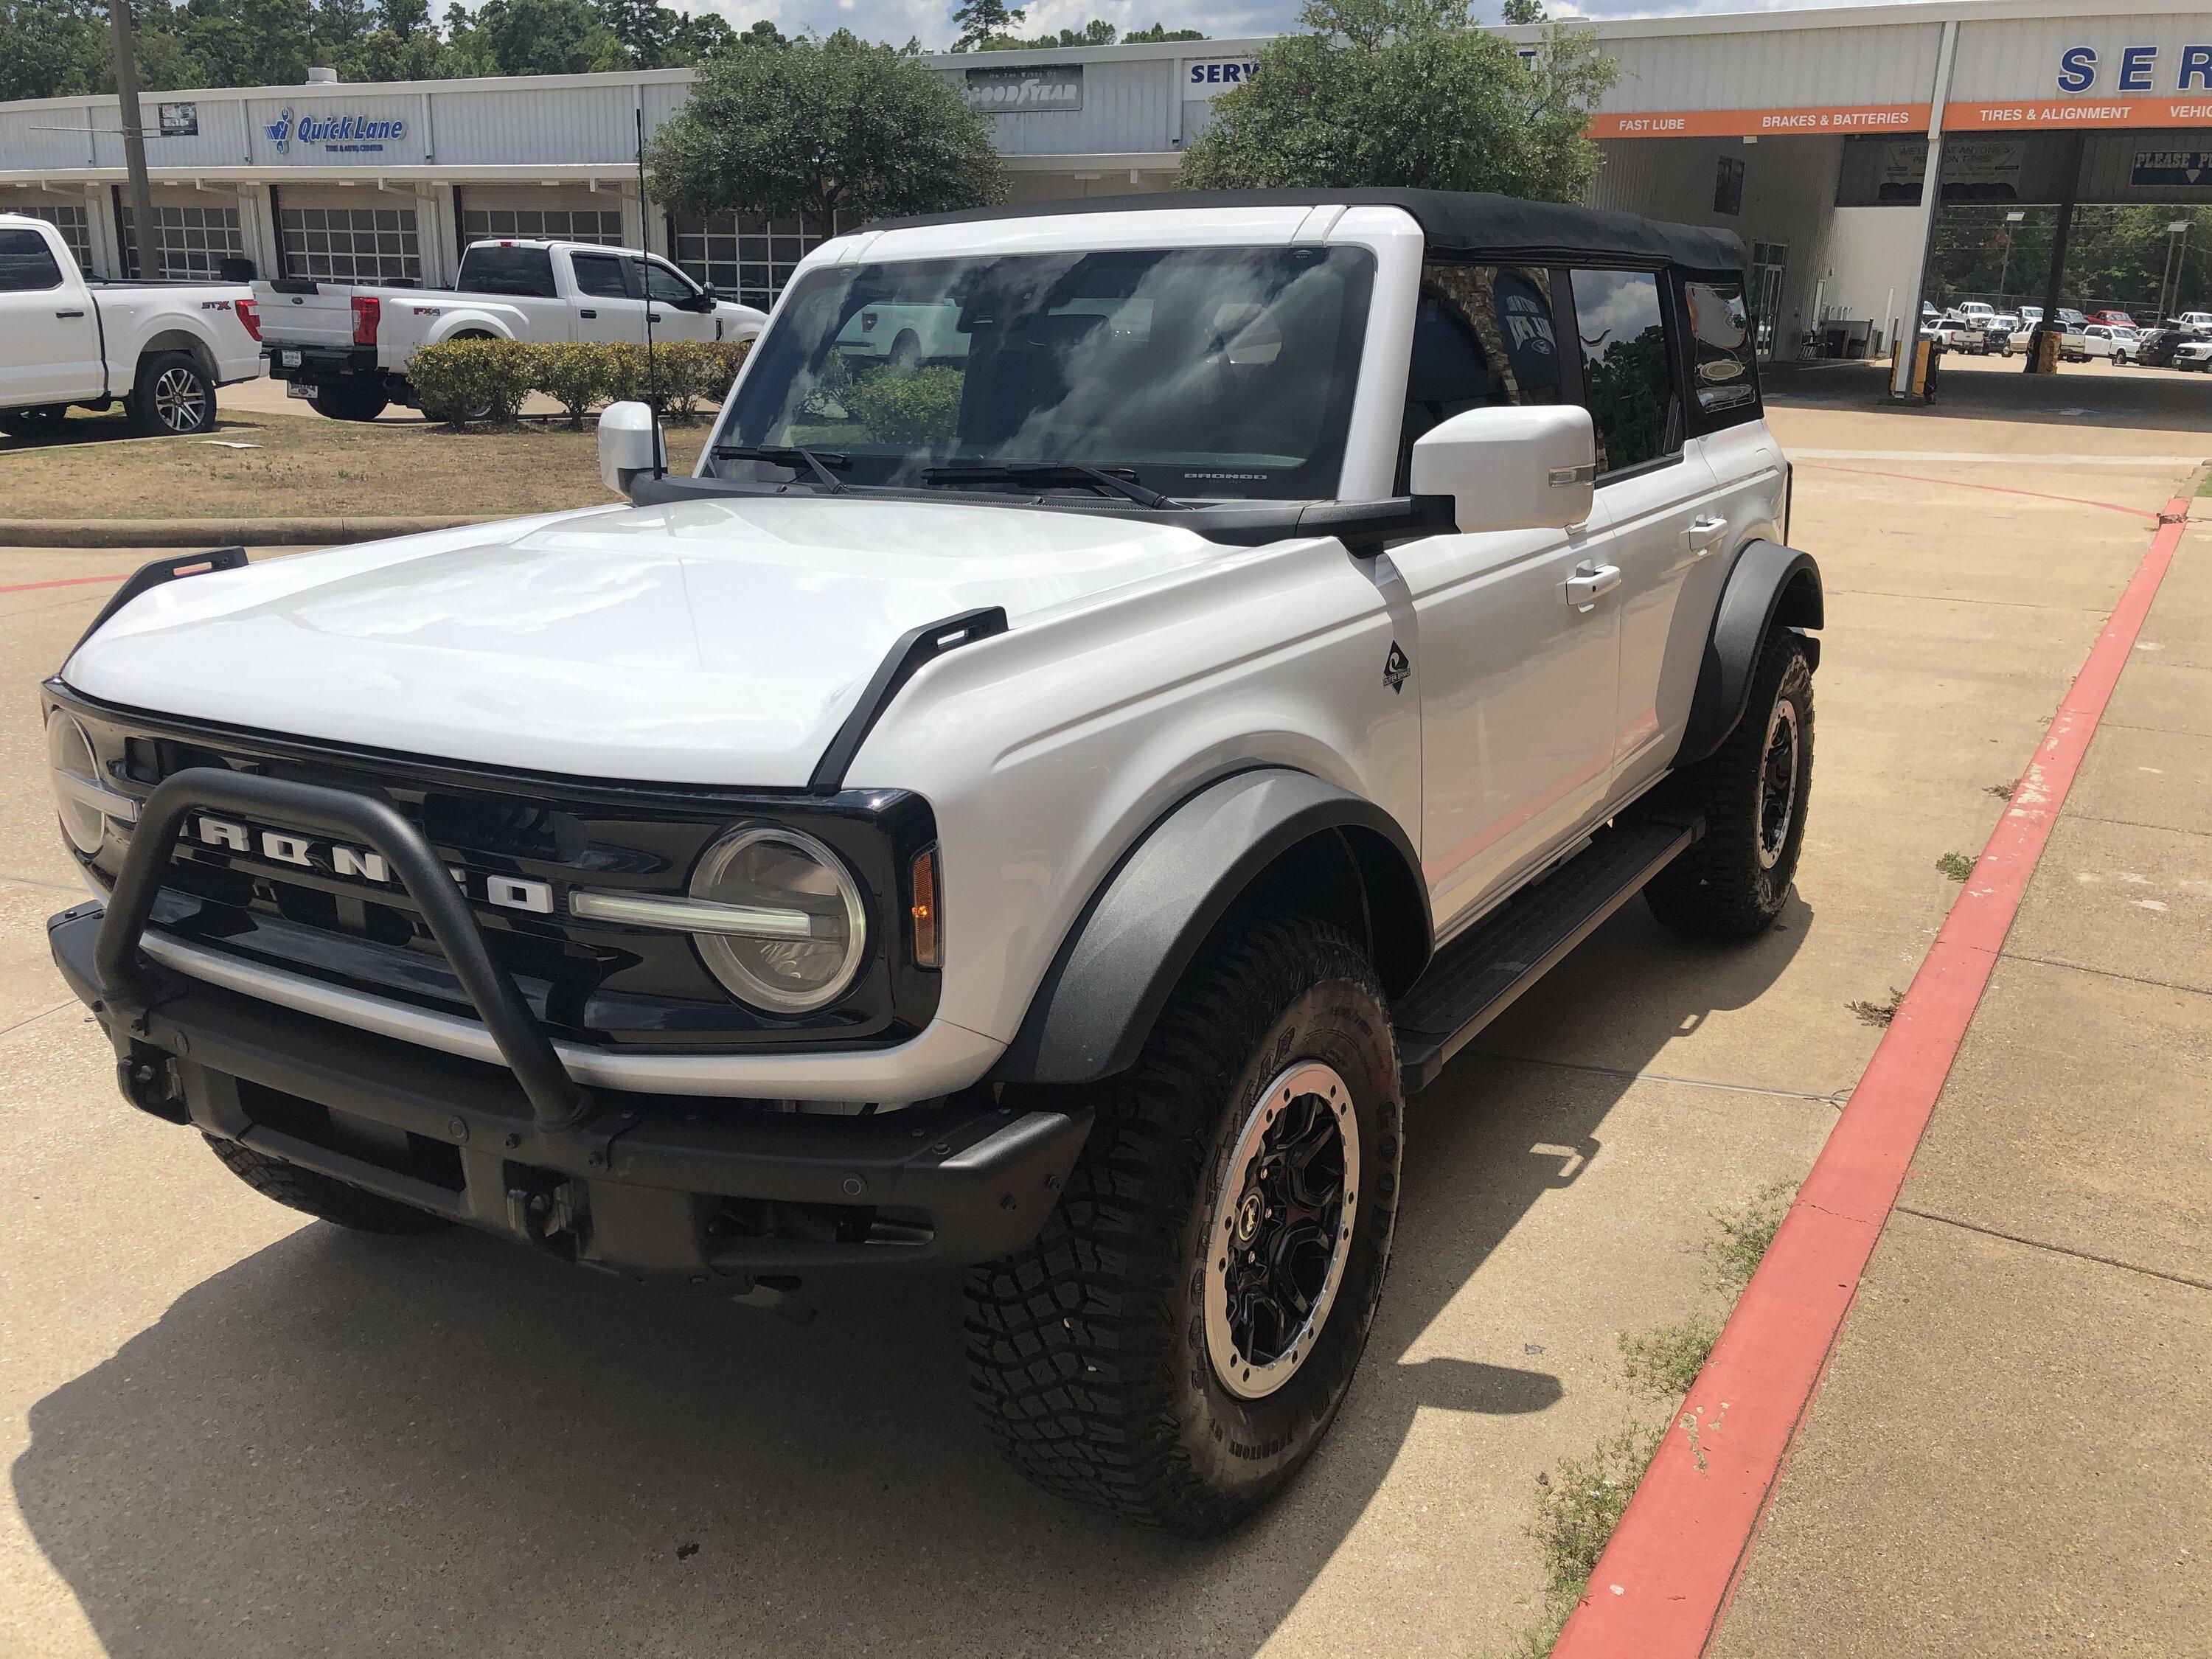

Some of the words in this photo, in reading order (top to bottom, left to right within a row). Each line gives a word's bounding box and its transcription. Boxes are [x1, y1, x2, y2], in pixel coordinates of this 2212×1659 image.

[1762, 115, 1816, 128] BRAKES
[1820, 115, 1829, 126] &
[1833, 112, 1910, 125] BATTERIES
[1980, 109, 2022, 122] TIRES
[2027, 109, 2037, 120] &
[2040, 106, 2132, 119] ALIGNMENT
[298, 116, 352, 143] Quick
[354, 115, 403, 139] Lane
[1619, 120, 1649, 131] FAST
[1652, 119, 1685, 130] LUBE
[2136, 153, 2191, 168] PLEASE
[201, 300, 231, 310] STX
